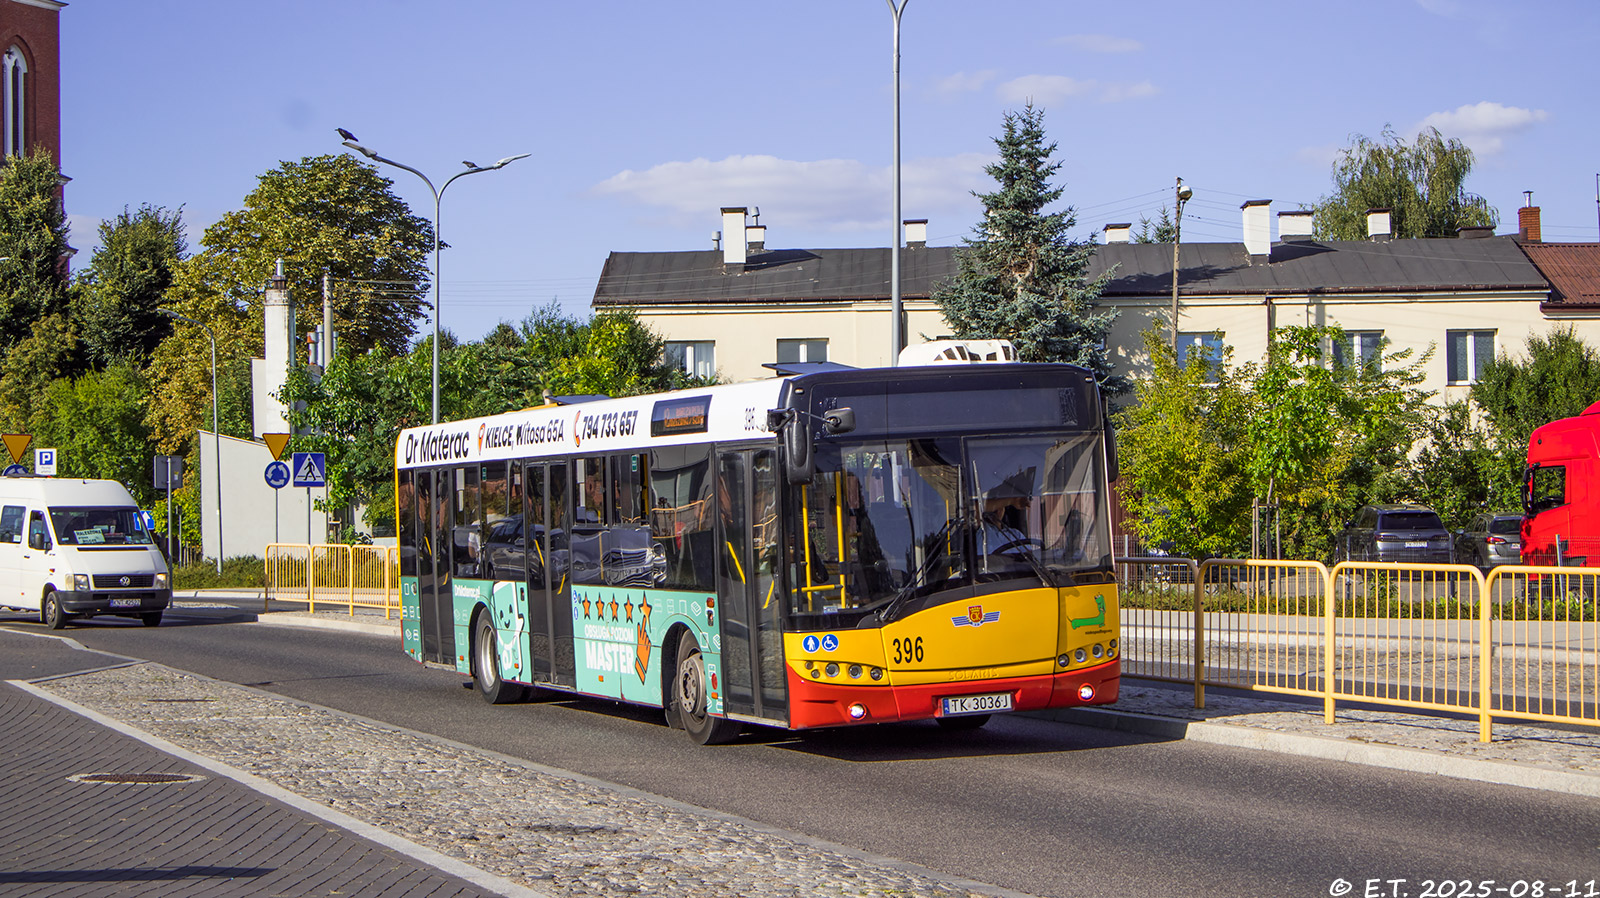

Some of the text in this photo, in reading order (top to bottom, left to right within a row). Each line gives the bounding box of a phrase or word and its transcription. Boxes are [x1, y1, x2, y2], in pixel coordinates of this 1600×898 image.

[485, 419, 565, 450] KIELCE, Witosa 65A
[582, 414, 600, 440] 794
[600, 412, 619, 438] 733
[619, 410, 639, 437] 657
[42, 452, 51, 464] P
[406, 429, 470, 464] Dr Materac
[610, 626, 634, 642] POZIOM
[585, 640, 635, 675] MASTER
[892, 636, 924, 664] 396
[948, 667, 1000, 682] SOLARIS
[951, 697, 968, 712] TK
